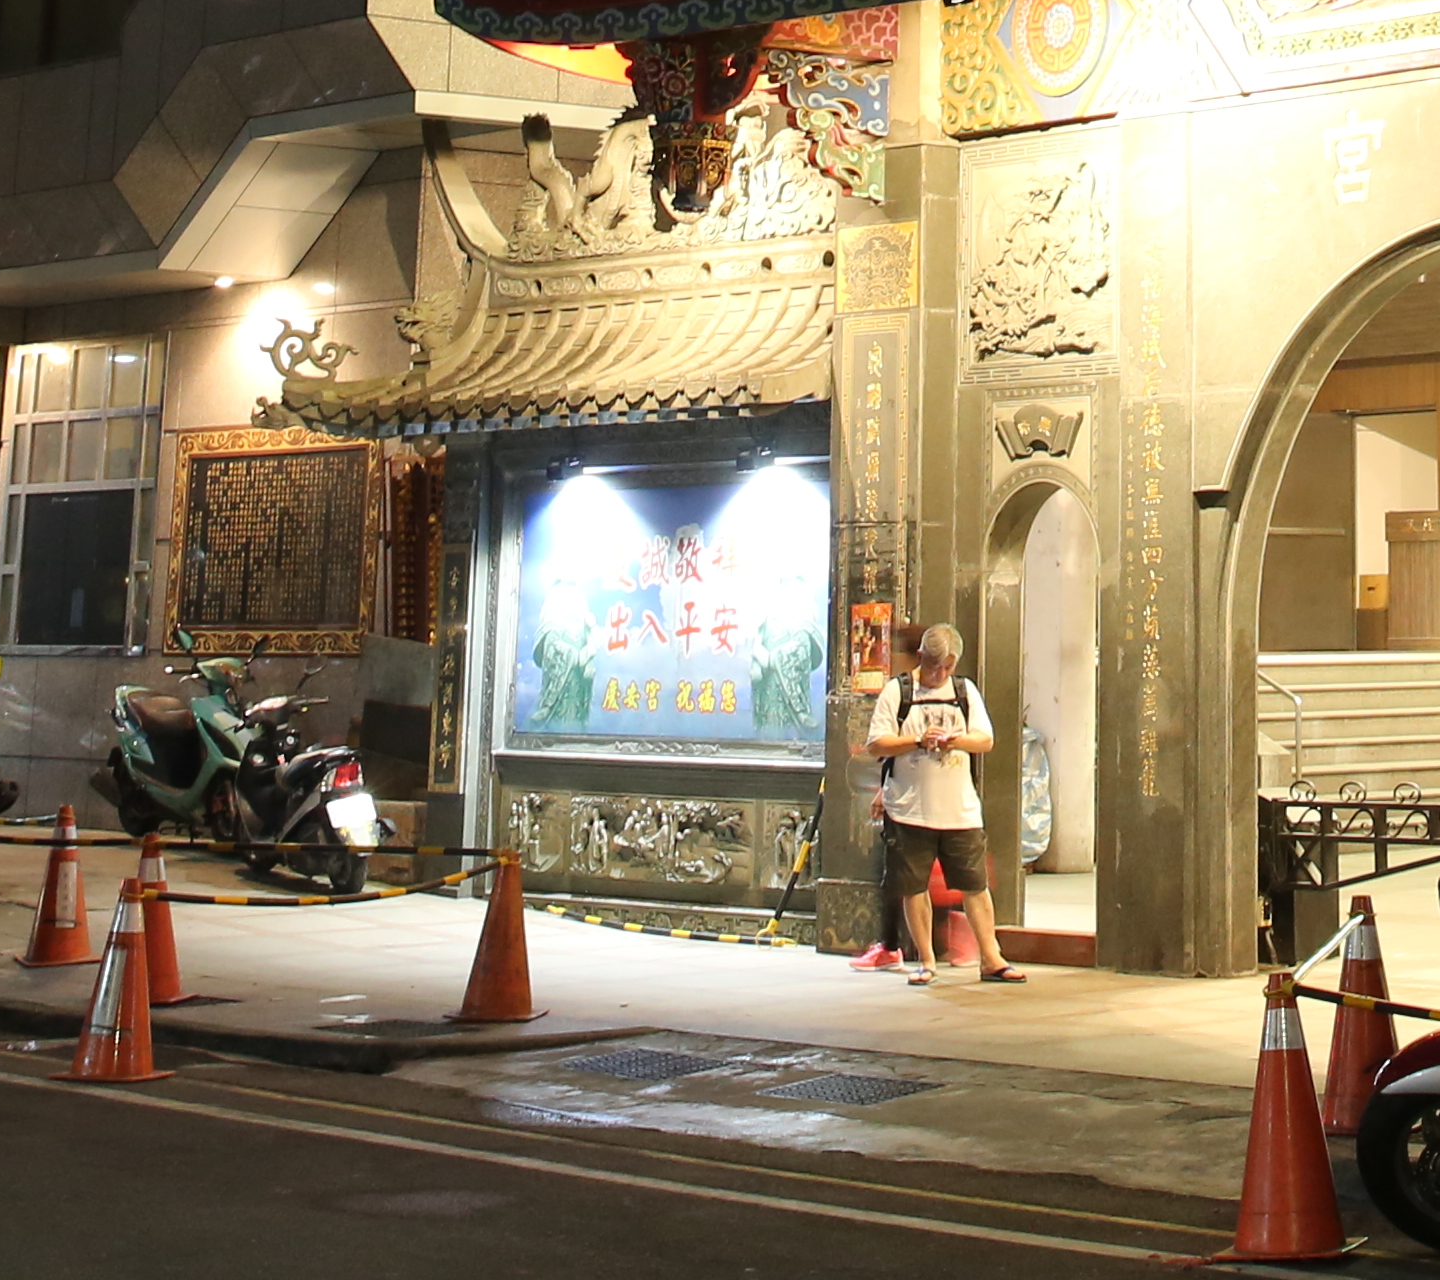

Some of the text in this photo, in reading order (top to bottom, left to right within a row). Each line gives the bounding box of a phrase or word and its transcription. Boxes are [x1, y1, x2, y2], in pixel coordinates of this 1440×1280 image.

[607, 602, 739, 655] 出入平安
[603, 679, 738, 714] 慶安宮 祝福您
